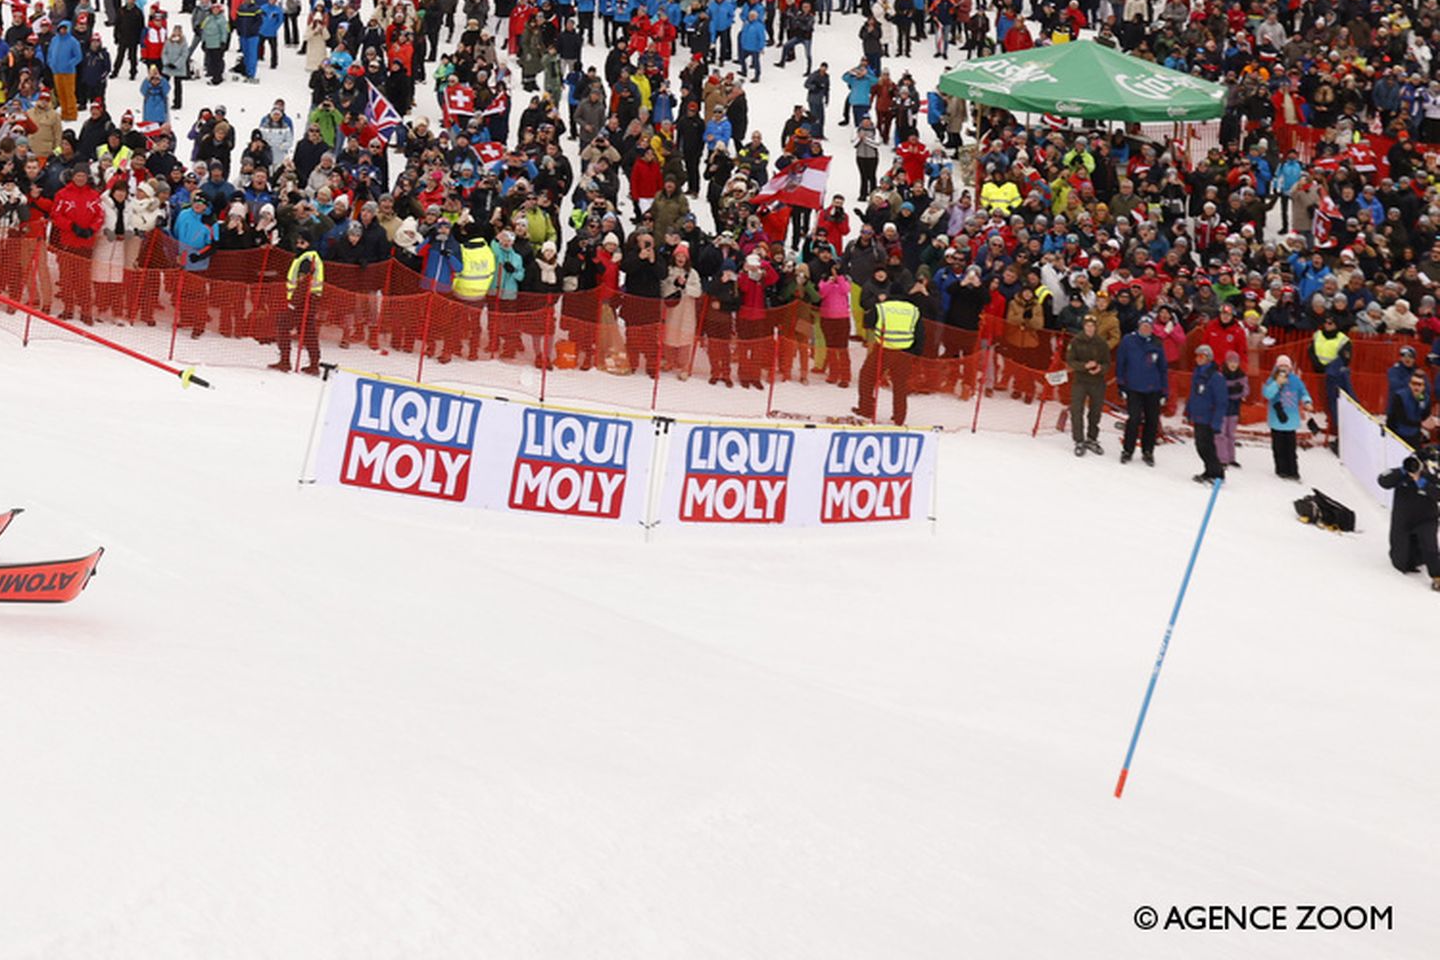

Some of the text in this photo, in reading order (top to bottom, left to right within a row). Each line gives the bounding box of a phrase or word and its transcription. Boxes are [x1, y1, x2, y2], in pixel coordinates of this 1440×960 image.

[357, 384, 475, 445] LIQUI
[524, 411, 629, 466] LIQUI
[345, 436, 471, 496] MOLY
[690, 429, 791, 474] LIQUI
[827, 434, 921, 477] LIQUI
[513, 463, 625, 514] MOLY
[683, 477, 786, 520] MOLY
[824, 478, 912, 520] MOLY
